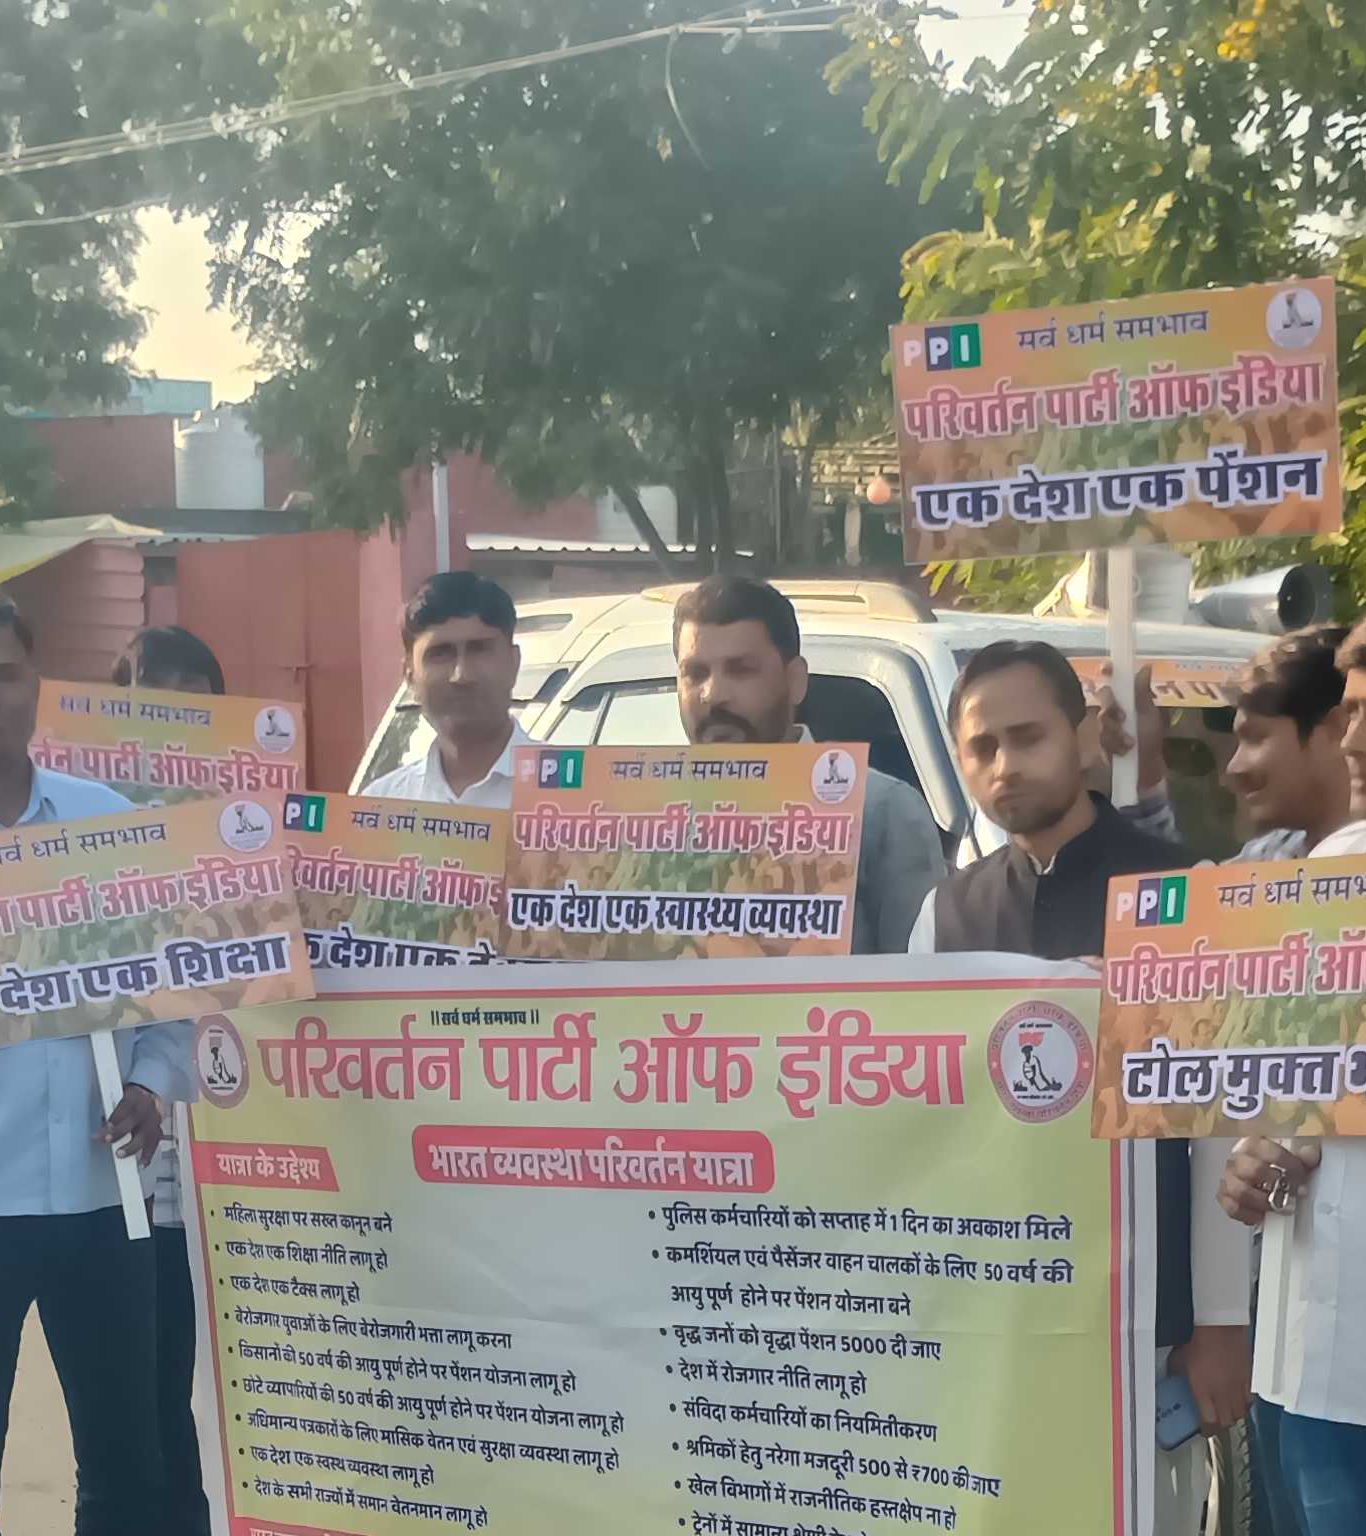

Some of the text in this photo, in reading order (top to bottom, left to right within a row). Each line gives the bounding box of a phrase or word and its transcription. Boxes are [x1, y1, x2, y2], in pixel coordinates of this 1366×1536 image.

[903, 334, 970, 366] PPI
[906, 356, 1322, 438] परिवर्तन पार्टी ऑफ इंडिया
[917, 451, 1322, 527] एक देश एक पेंशन
[82, 741, 141, 781] पार्टी
[150, 745, 212, 786] ऑफ
[218, 749, 296, 793] इंडिया
[31, 829, 69, 858] धर्म
[75, 822, 167, 855] समभाव
[516, 803, 851, 859] परिवर्तन पार्टी ऑफ इंडिया
[21, 879, 92, 928] पार्टी
[101, 870, 176, 917] ऑफ
[186, 857, 280, 908] इंडिया
[362, 855, 420, 900] पार्टी
[423, 859, 483, 907] ऑफ
[1117, 892, 1177, 920] PPI
[511, 893, 556, 928] एक
[561, 884, 601, 931] देश
[606, 895, 650, 930] एक
[749, 897, 844, 935] व्यवस्था
[80, 957, 157, 996] एक
[167, 935, 288, 984] शिक्षा
[1110, 940, 1227, 1003] परिवर्तन
[1236, 932, 1310, 995] पार्टी
[256, 1014, 465, 1100] परिवर्तन
[478, 1013, 596, 1102] पार्टी
[613, 1013, 760, 1104] ऑफ
[776, 1006, 966, 1119] इंडिया
[1128, 1045, 1216, 1097] टोल
[1227, 1052, 1340, 1111] मुक्त
[216, 1147, 320, 1186] यात्रा के उद्देश्य
[429, 1135, 754, 1186] भारत व्यवस्था परिवर्तन यात्रा
[662, 1202, 1072, 1240] पुलिस कर्मचारियों को सप्ताह में 1 दिन का अवकाश मिले
[672, 1322, 941, 1360] वृद्ध जनों को वृद्धा पेंशन 5000 दी जाए
[686, 1435, 736, 1460] श्रमिकों
[739, 1440, 763, 1470] हेतु
[765, 1443, 800, 1466] नरेगा
[803, 1450, 854, 1480] मजदूरी
[859, 1458, 890, 1478] 500
[894, 1456, 908, 1480] से
[952, 1465, 969, 1490] की
[971, 1474, 1001, 1497] जाए
